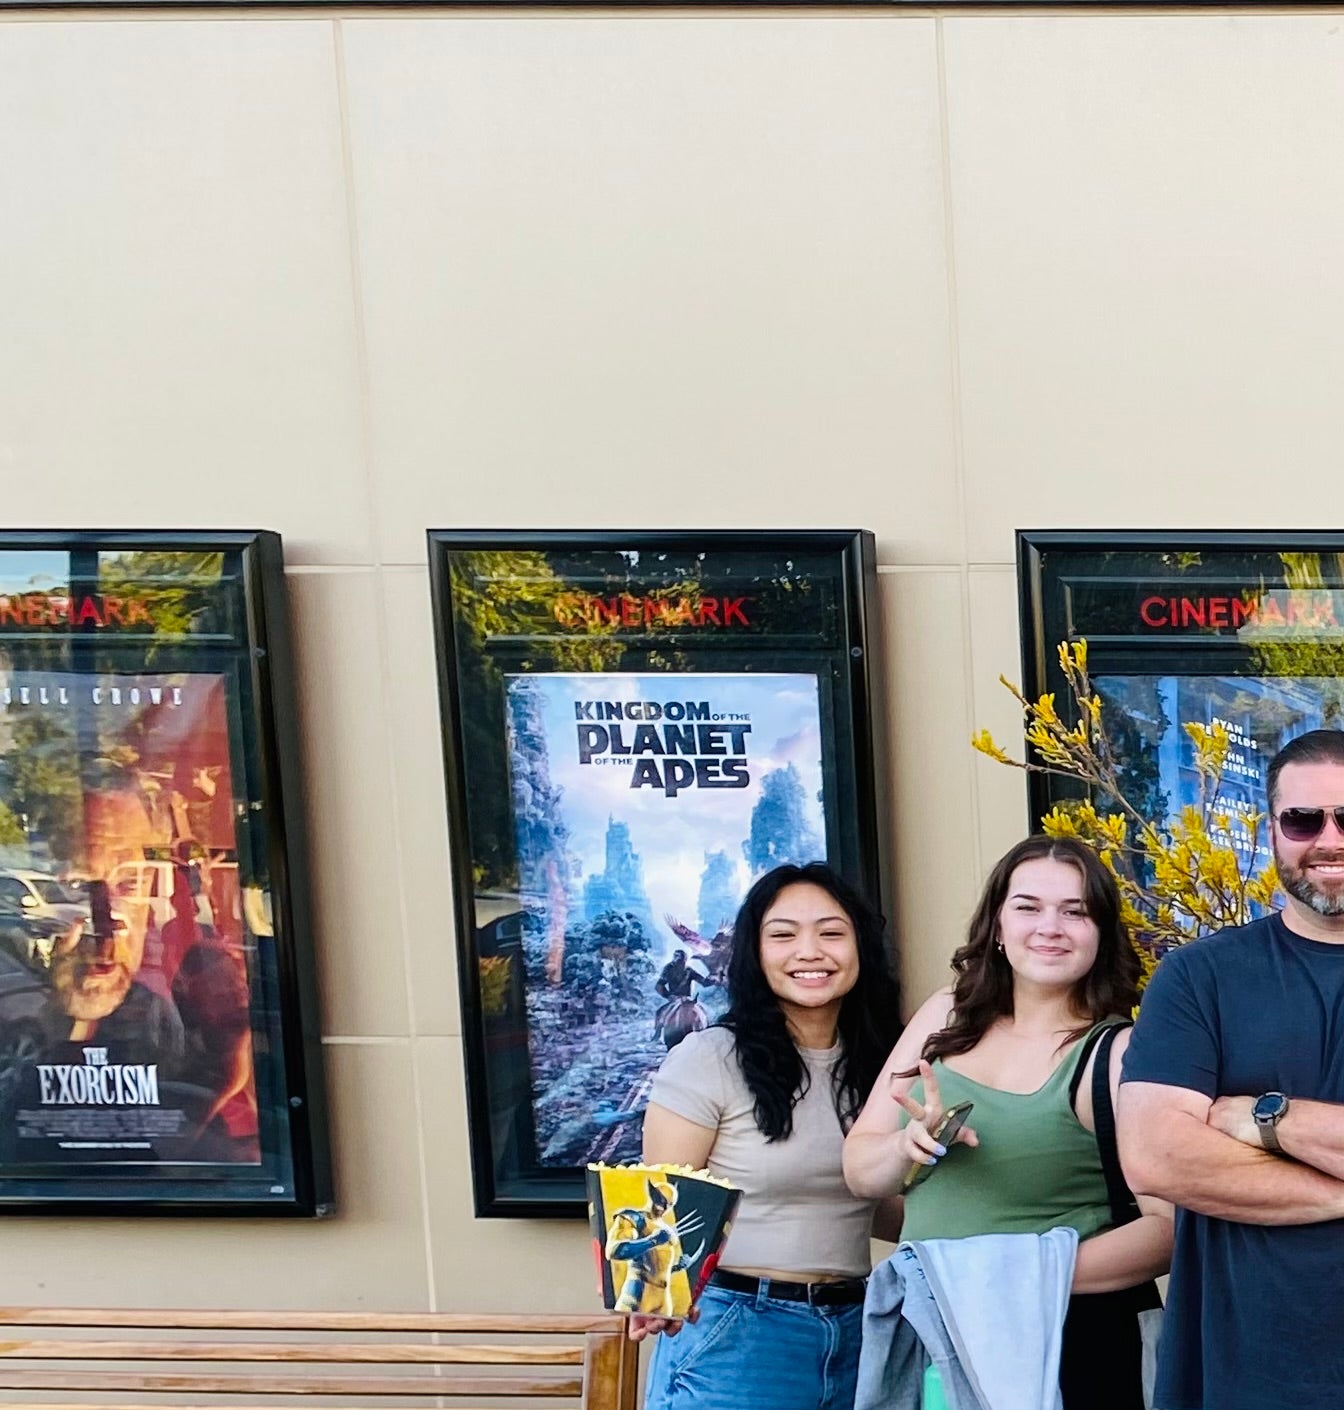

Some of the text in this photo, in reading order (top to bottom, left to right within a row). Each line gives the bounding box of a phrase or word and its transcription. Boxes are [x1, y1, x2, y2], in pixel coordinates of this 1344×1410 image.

[0, 595, 155, 626] NEMARK
[554, 596, 751, 627] CINEMARK
[1140, 596, 1339, 627] CINEMARK
[2, 686, 182, 705] SELL CROWE
[574, 701, 751, 721] KINGDOM OF THE
[577, 724, 752, 765] PLANET
[594, 757, 633, 766] OF THE
[1221, 760, 1260, 780] SINSKI
[630, 758, 751, 798] APES
[81, 1047, 109, 1065] THE
[36, 1064, 160, 1105] EXORCISM
